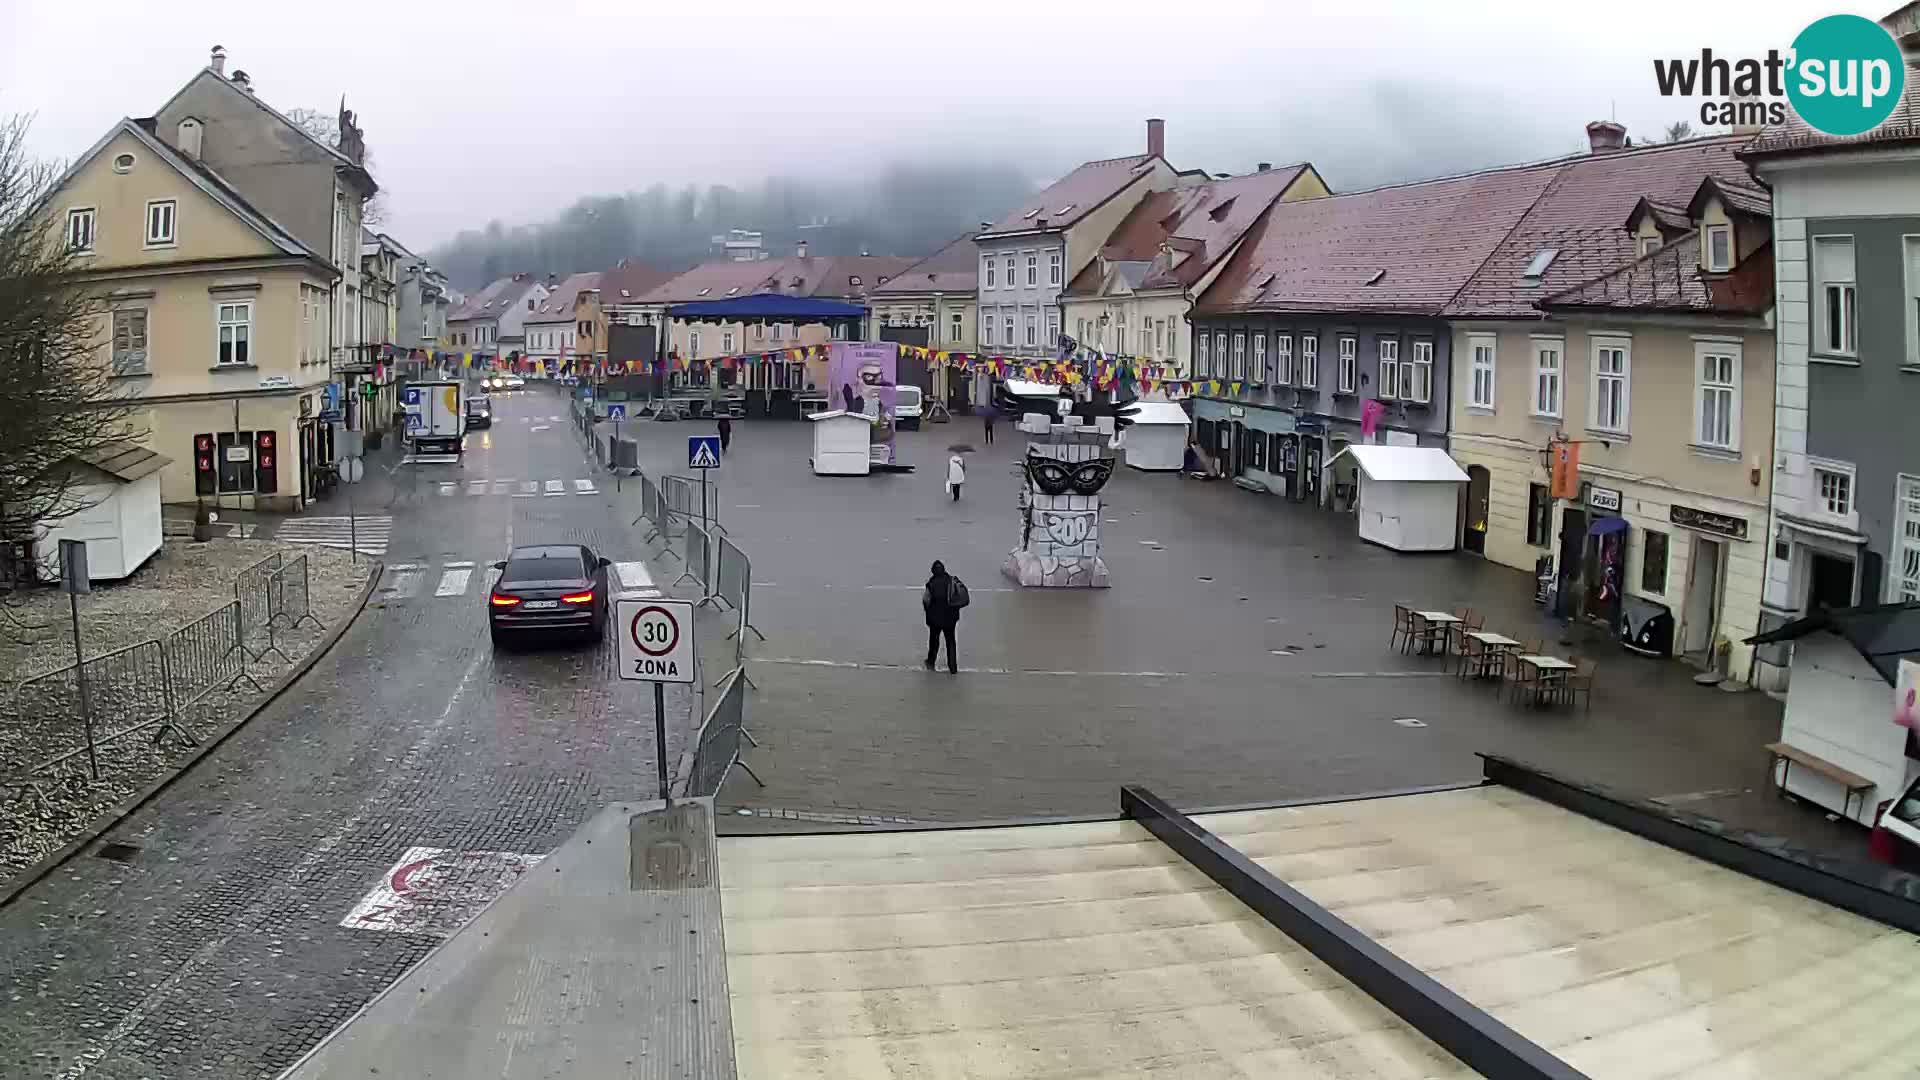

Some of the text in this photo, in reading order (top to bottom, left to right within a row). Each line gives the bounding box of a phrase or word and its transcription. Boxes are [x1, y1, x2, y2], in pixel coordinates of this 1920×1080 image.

[1047, 516, 1087, 544] 200
[643, 622, 668, 643] 30
[634, 659, 679, 676] ZONA
